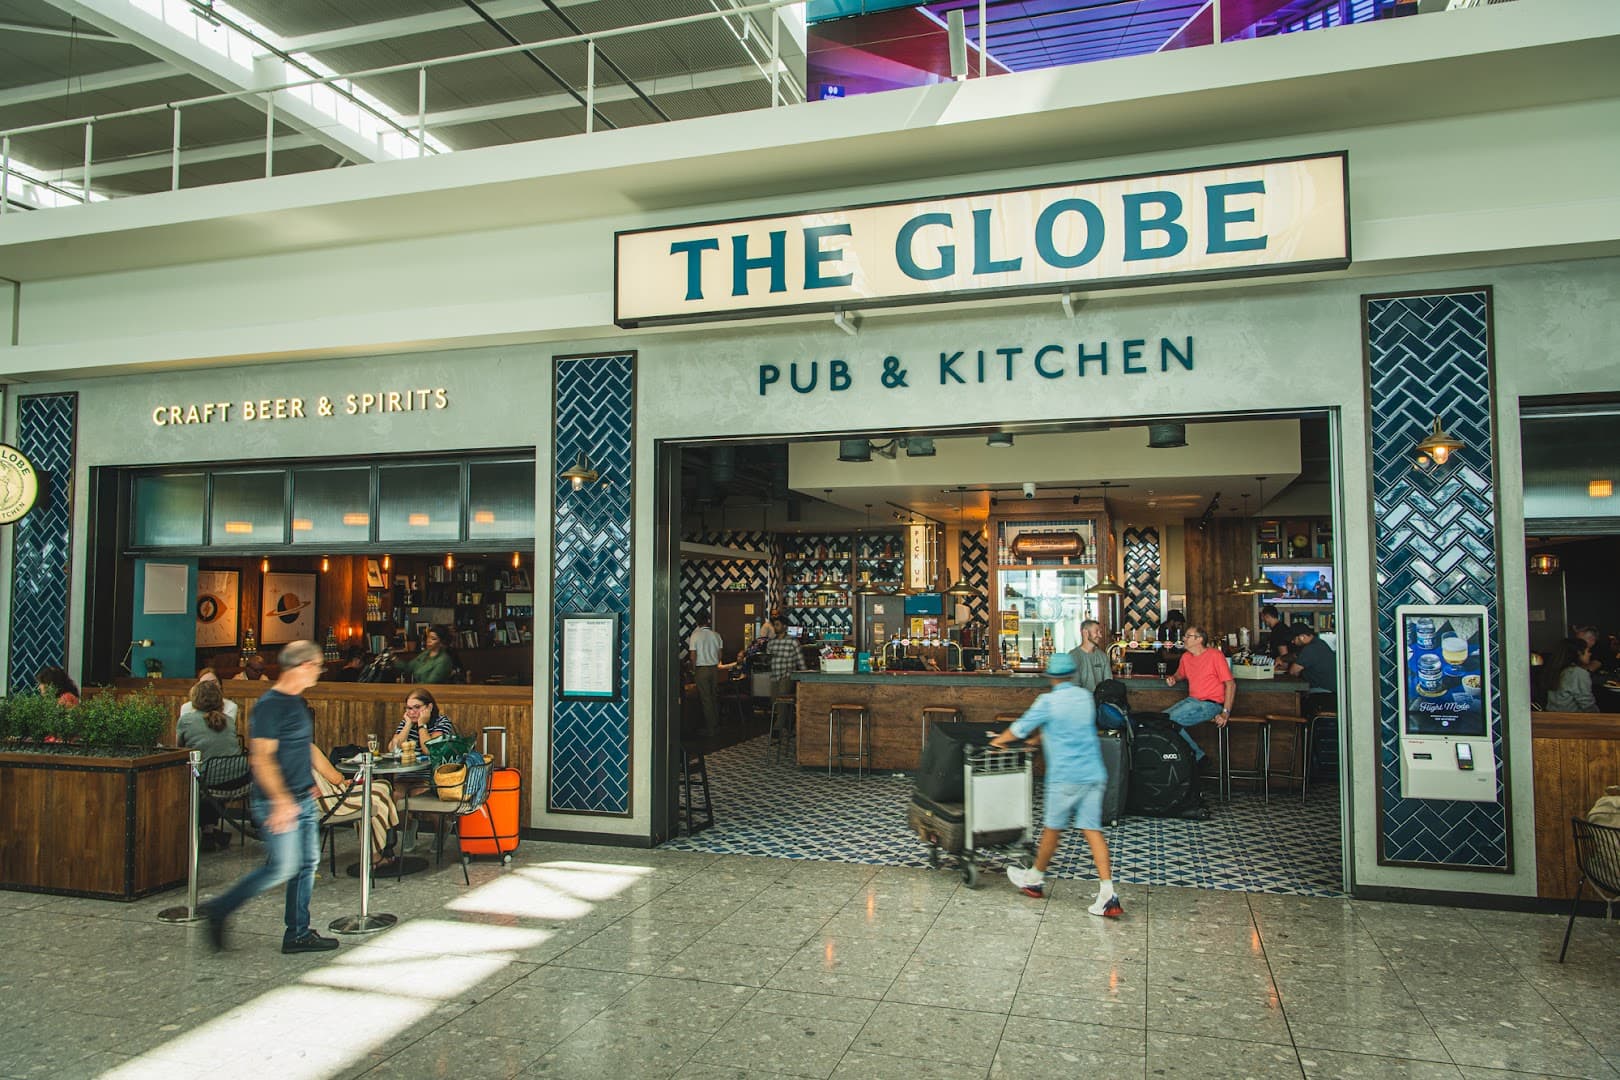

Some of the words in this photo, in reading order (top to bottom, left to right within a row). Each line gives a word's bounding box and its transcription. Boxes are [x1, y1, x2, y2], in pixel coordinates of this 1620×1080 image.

[670, 223, 854, 301] THE
[895, 180, 1269, 280] GLOBE
[760, 360, 853, 395] PUB
[881, 355, 909, 388] &
[940, 336, 1194, 385] KITCHEN
[152, 403, 231, 426] CRAFT
[243, 398, 305, 420] BEER
[317, 396, 333, 417] &
[346, 388, 448, 415] SPIRITS
[1, 450, 31, 476] LOBE
[1420, 702, 1443, 712] Flight
[1444, 702, 1470, 712] Mode
